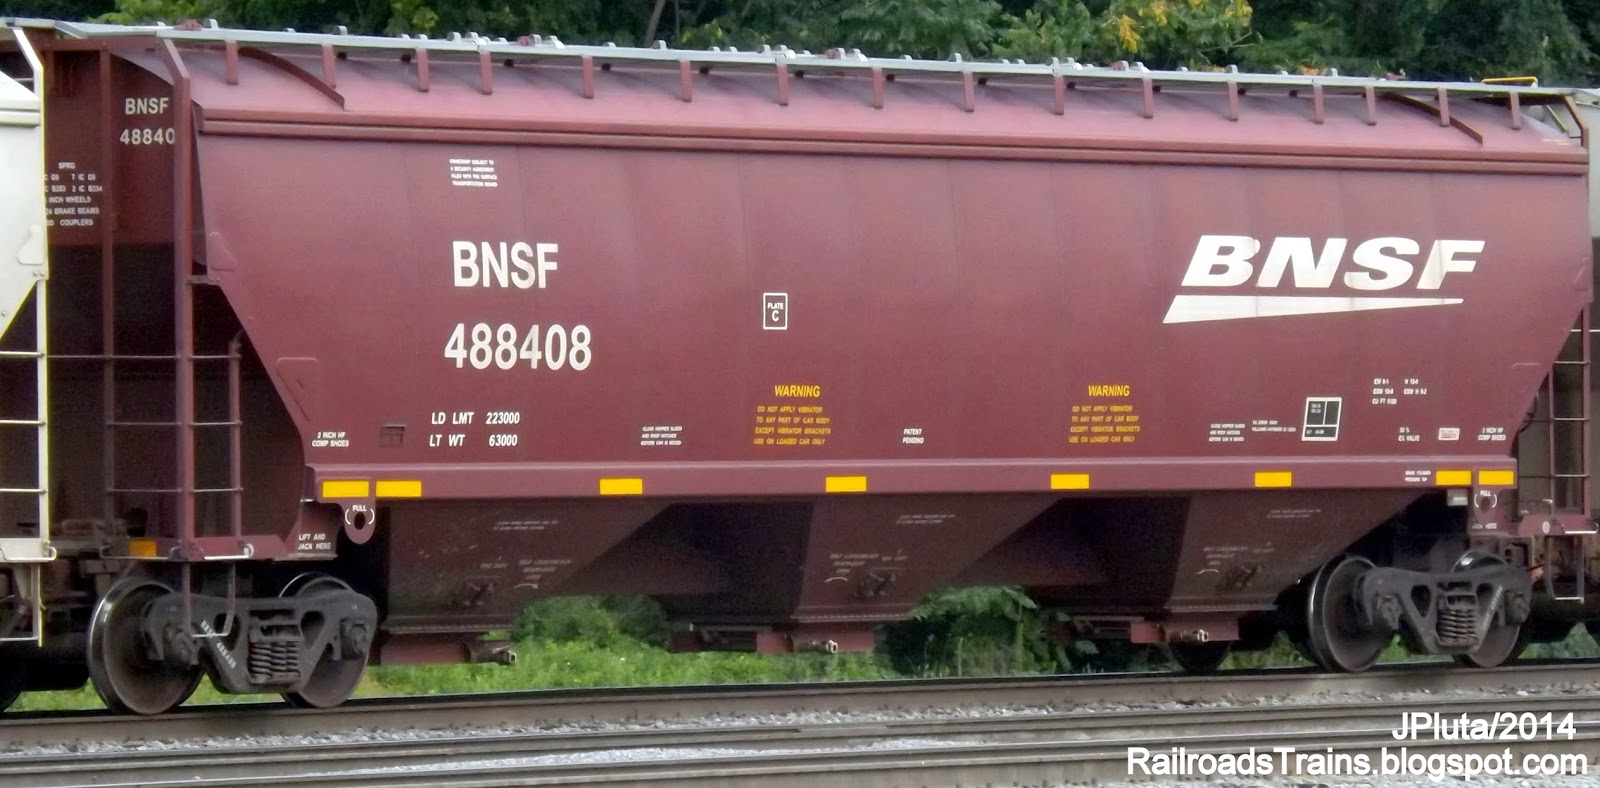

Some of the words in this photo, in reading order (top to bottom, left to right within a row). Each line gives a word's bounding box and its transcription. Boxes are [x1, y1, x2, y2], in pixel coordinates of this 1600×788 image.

[125, 97, 169, 115] BNSF
[452, 240, 559, 289] BNSF
[1180, 235, 1486, 291] BNSF
[767, 302, 784, 310] PLATE
[771, 310, 780, 322] C
[444, 322, 592, 371] 488408
[774, 384, 821, 398] WARNING
[1088, 384, 1131, 397] WARNING
[431, 412, 446, 424] LD
[452, 412, 475, 424] LMT
[485, 411, 520, 424] 223000
[317, 431, 322, 439] 2
[322, 431, 337, 439] INCH
[903, 428, 923, 436] PATENT
[429, 434, 443, 447] LT
[448, 434, 466, 447] WT
[488, 434, 518, 447] 63000
[902, 436, 925, 444] PENDING
[298, 533, 311, 541] LIFT
[313, 533, 326, 541] AND
[297, 542, 313, 551] JACK
[315, 542, 331, 550] HERE
